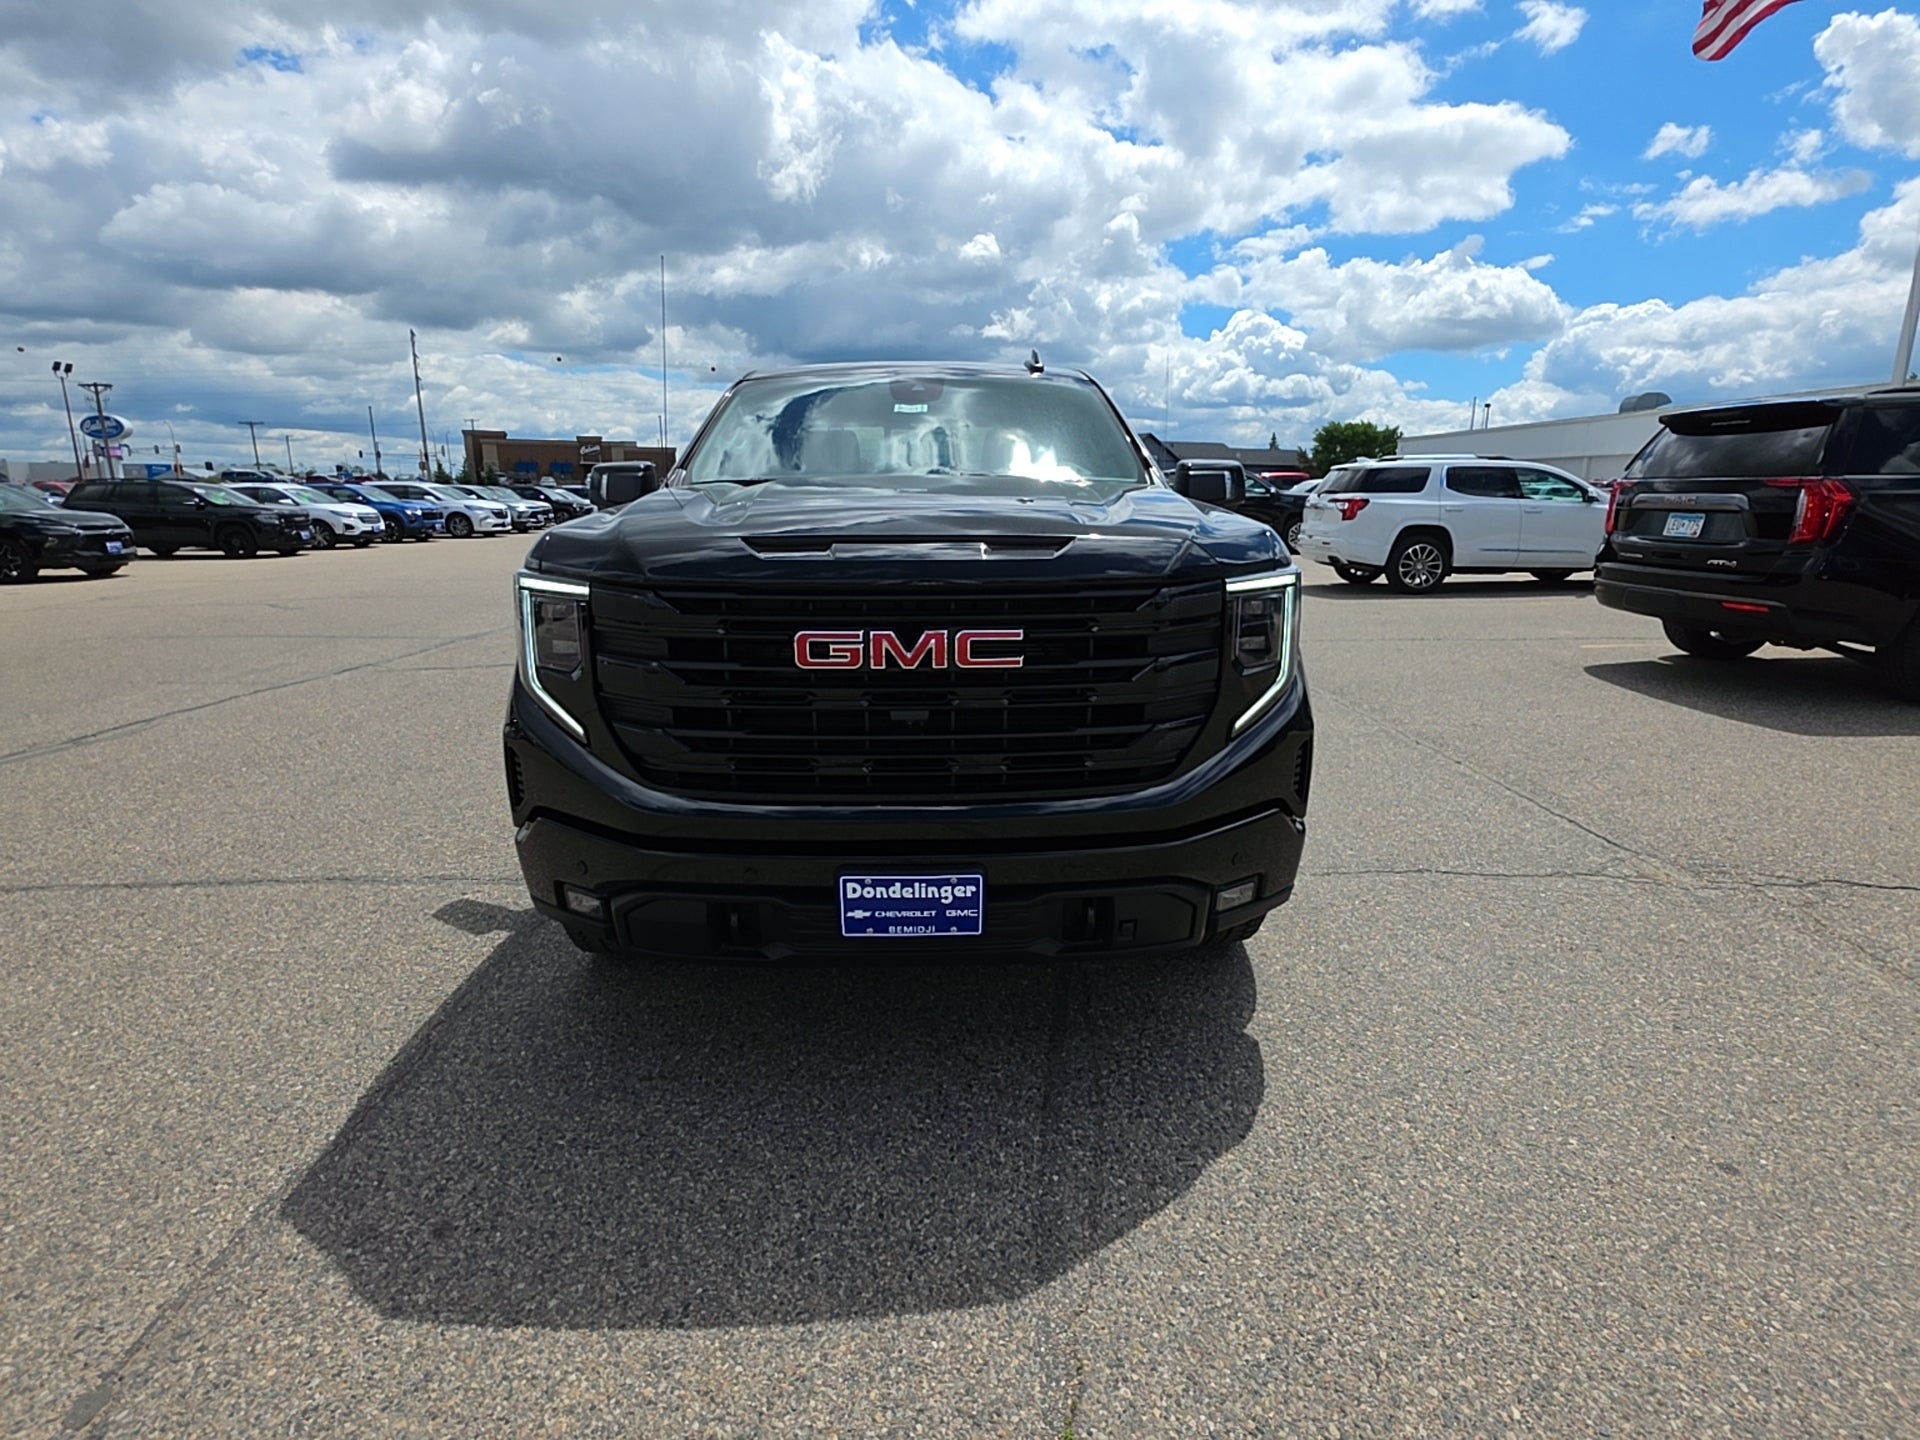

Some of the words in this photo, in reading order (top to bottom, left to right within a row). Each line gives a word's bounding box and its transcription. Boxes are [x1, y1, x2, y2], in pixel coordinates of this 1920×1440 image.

[794, 629, 1024, 669] GMC
[846, 882, 977, 904] Dondelinger
[874, 910, 937, 918] CHEVROLET
[945, 909, 978, 917] GMC
[888, 925, 936, 934] BEMIDJI
